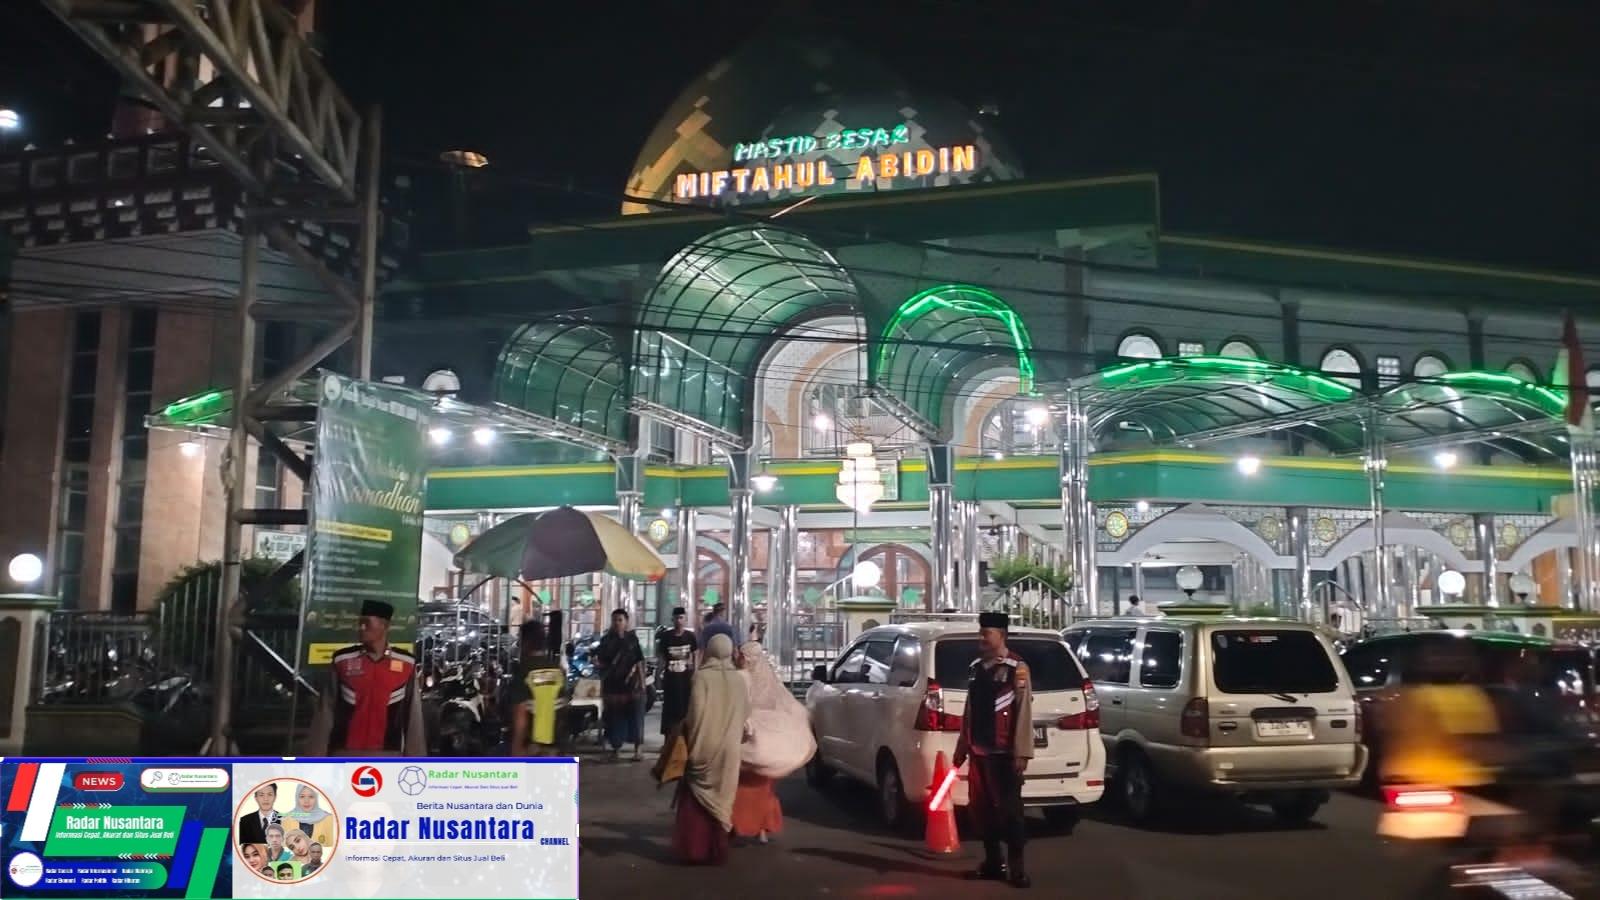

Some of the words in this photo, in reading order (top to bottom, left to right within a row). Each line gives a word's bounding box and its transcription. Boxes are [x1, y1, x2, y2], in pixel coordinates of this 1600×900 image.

[825, 124, 909, 150] BESAR
[675, 160, 835, 198] MIFTAHUL
[856, 145, 976, 181] ABIDIN
